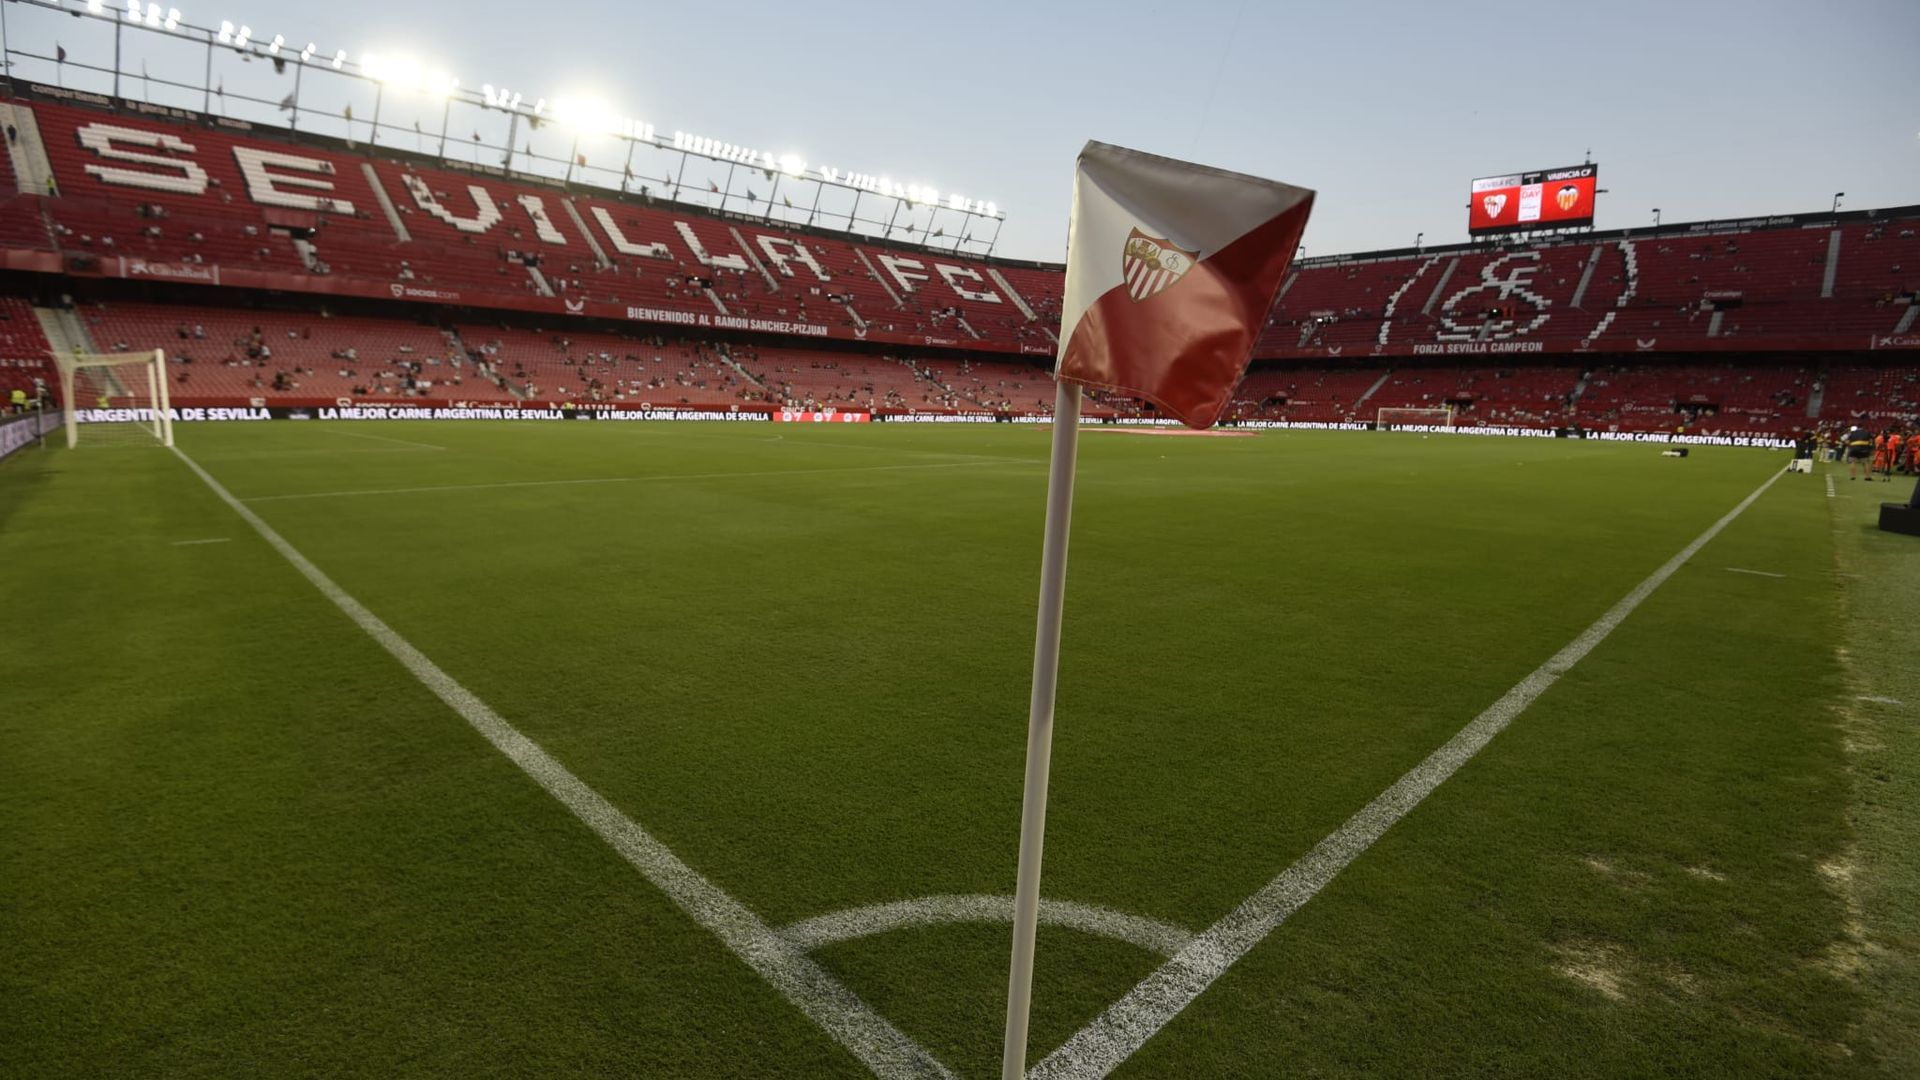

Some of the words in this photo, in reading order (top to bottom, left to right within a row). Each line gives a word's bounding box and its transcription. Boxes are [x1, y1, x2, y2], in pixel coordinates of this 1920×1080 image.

[1547, 170, 1580, 180] VALENCIA
[1522, 190, 1540, 199] DAY
[76, 121, 831, 282] SEVILLA
[878, 253, 1003, 304] FC
[627, 306, 695, 325] BIENVENIDOS
[699, 314, 711, 326] AL
[714, 315, 748, 330] RAMON
[749, 319, 828, 336] SANCHEZ-PIZJUAN
[1413, 344, 1444, 354] FORZA
[1447, 343, 1487, 353] SEVILLA
[1490, 342, 1543, 352] CAMPEON
[182, 408, 207, 420] DE
[207, 408, 271, 420] SEVILLA
[318, 408, 338, 419] LA
[340, 408, 387, 419] MEJOR
[388, 408, 433, 419] CARNE
[433, 409, 501, 420] ARGENTINA
[503, 409, 519, 420] DE
[521, 409, 564, 420] SEVILLA
[596, 410, 609, 420] LA
[611, 410, 644, 420] MEJOR
[644, 411, 675, 421] CARNE
[676, 411, 725, 421] ARGENTINA
[726, 411, 738, 421] DE
[738, 411, 769, 421] SEVILLA
[1237, 420, 1246, 428] LA
[1246, 421, 1267, 429] MEJOR
[1290, 422, 1328, 430] ARGENTINA
[1339, 423, 1368, 431] SEVILLA
[1390, 424, 1401, 432] LA
[1429, 425, 1457, 433] CARNE
[1457, 426, 1506, 435] ARGENTINA
[1507, 428, 1519, 436] DE
[1520, 428, 1556, 438] SEVILLA
[1586, 431, 1599, 440] LA
[1600, 432, 1634, 441] MEJOR
[1635, 433, 1669, 443] CARNE
[1671, 435, 1732, 445] ARGENTINA
[1734, 436, 1749, 446] DE
[1750, 438, 1796, 448] SEVILLA
